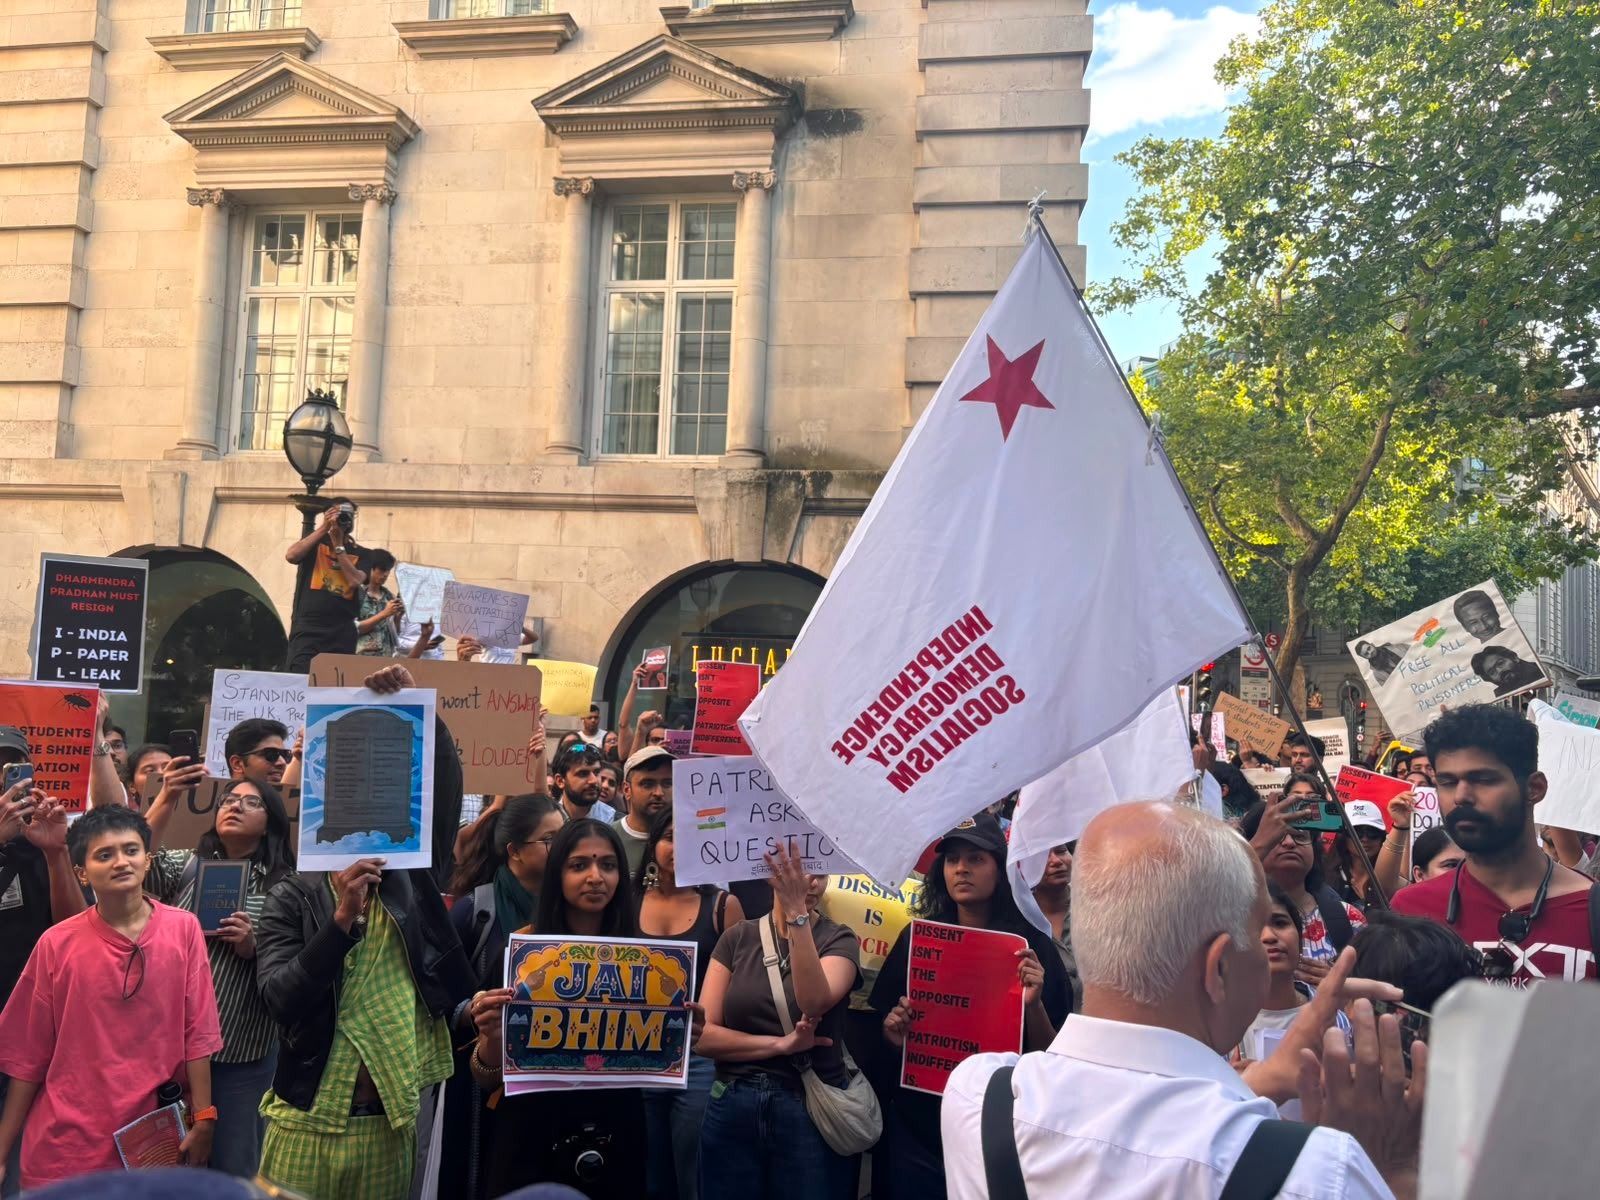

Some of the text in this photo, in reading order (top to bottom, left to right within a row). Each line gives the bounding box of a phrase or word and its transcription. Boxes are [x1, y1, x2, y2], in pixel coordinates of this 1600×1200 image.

[55, 573, 136, 588] DHARMENDRA
[49, 587, 140, 601] PRADHAN MUST
[71, 602, 115, 613] RESIGN
[55, 627, 63, 639] I
[78, 628, 128, 642] INDIA
[1270, 634, 1278, 646] S
[51, 646, 62, 658] P
[77, 648, 129, 661] PAPER
[1399, 638, 1465, 679] FREE ALL
[56, 667, 65, 679] L
[81, 668, 121, 681] LEAK
[1411, 664, 1468, 695] POLITICAL
[222, 673, 305, 703] STANDING
[700, 685, 713, 693] THE
[1417, 674, 1483, 713] PRISONERS
[440, 686, 481, 710] won't
[698, 697, 731, 706] OPPOSITE
[220, 706, 245, 721] THE
[20, 726, 92, 738] STUDENTS
[29, 745, 91, 756] RE SHINE
[34, 763, 80, 773] ATION
[1341, 766, 1373, 780] DISSENT
[690, 769, 774, 796] PATRI
[1338, 778, 1357, 789] ISN'T
[750, 802, 804, 823] ASK
[701, 833, 834, 865] QUESTIO
[864, 908, 883, 926] IS
[914, 924, 964, 942] DISSENT
[912, 945, 943, 961] ISN'T
[553, 962, 651, 1002] JAI
[911, 967, 936, 982] THE
[911, 989, 970, 1008] OPPOSITE
[910, 1010, 925, 1021] OF
[526, 1006, 667, 1051] BHIM
[908, 1031, 980, 1053] PATRIOTISM
